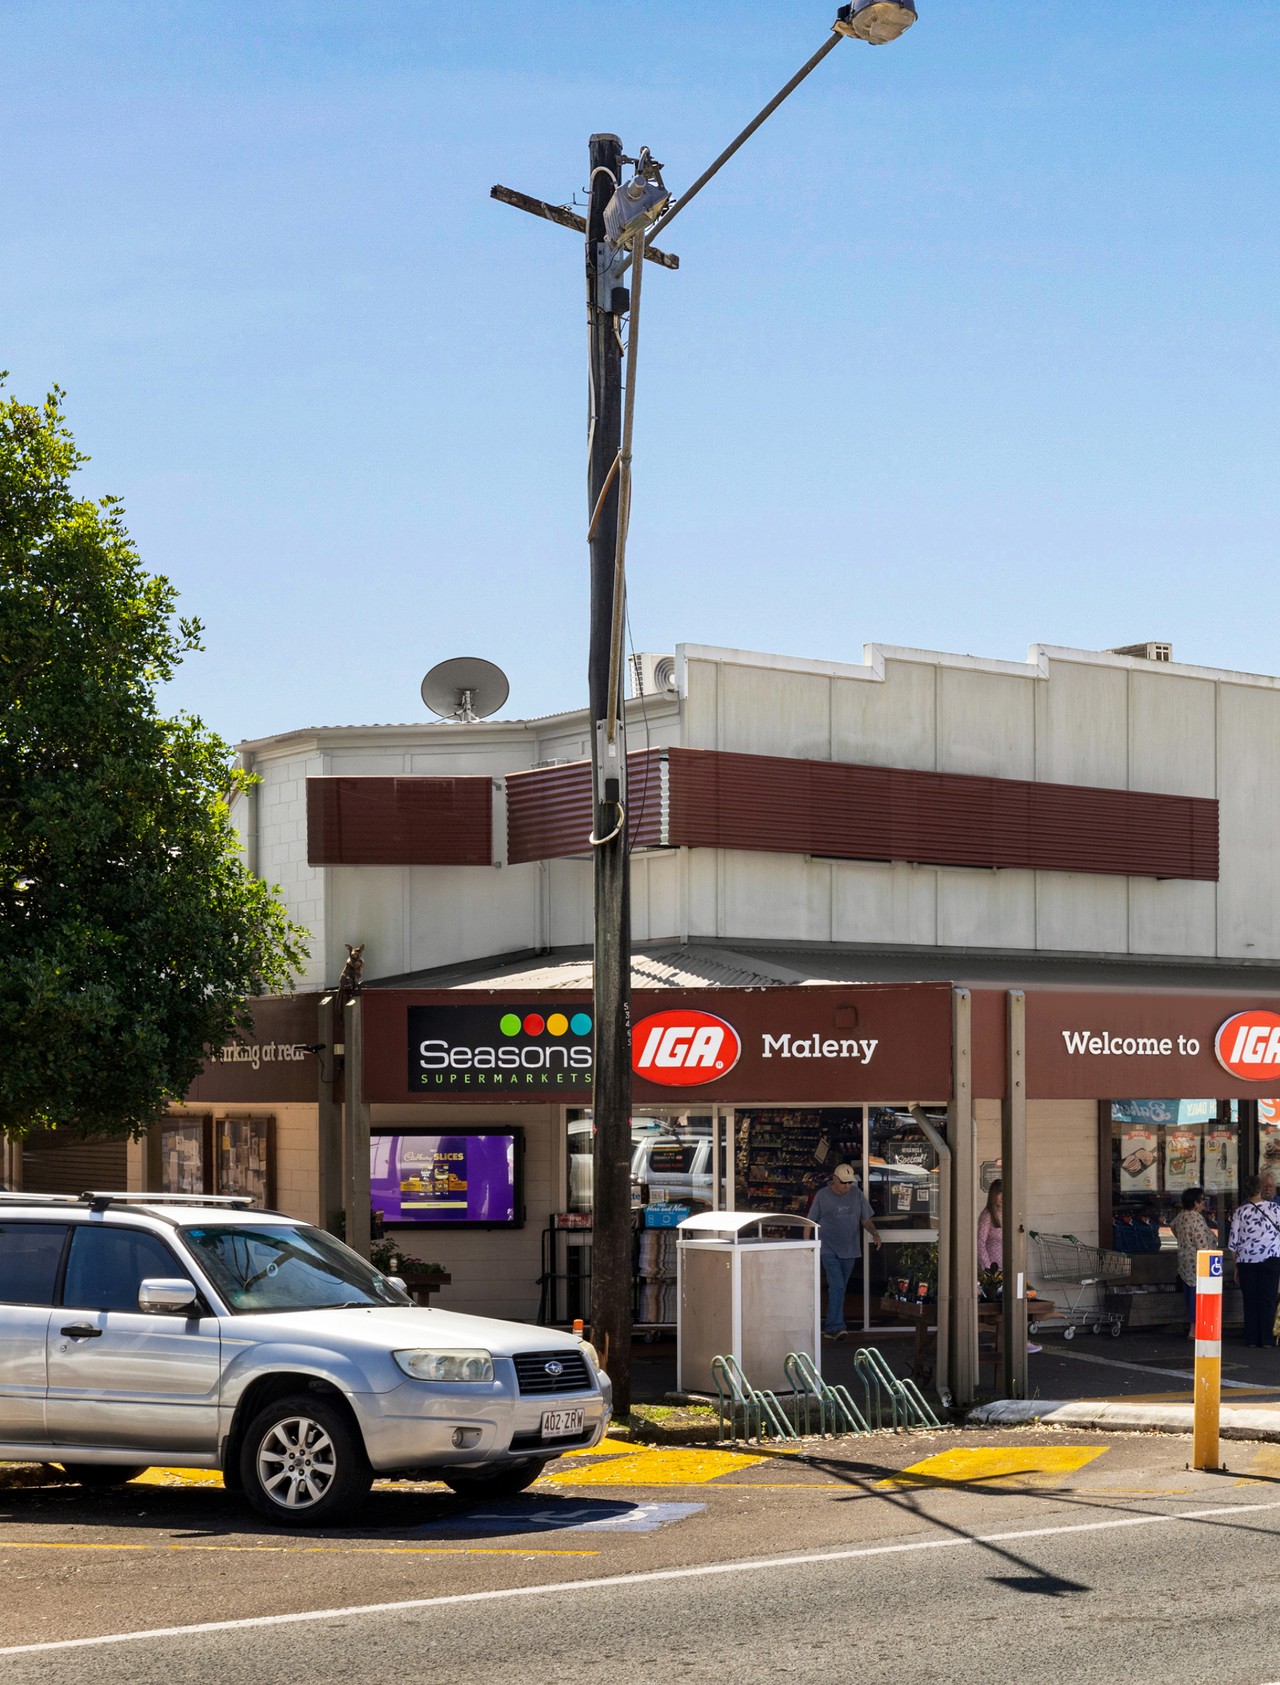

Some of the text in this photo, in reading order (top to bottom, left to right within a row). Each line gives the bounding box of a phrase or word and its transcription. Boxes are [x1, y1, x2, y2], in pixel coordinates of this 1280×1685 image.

[262, 1041, 276, 1061] at
[420, 1040, 593, 1069] Seasons
[637, 1026, 724, 1068] IGA
[762, 1033, 878, 1064] Maleny
[1062, 1030, 1173, 1056] Welcome
[1177, 1034, 1200, 1056] to
[421, 1074, 592, 1084] SUPERMARKETS
